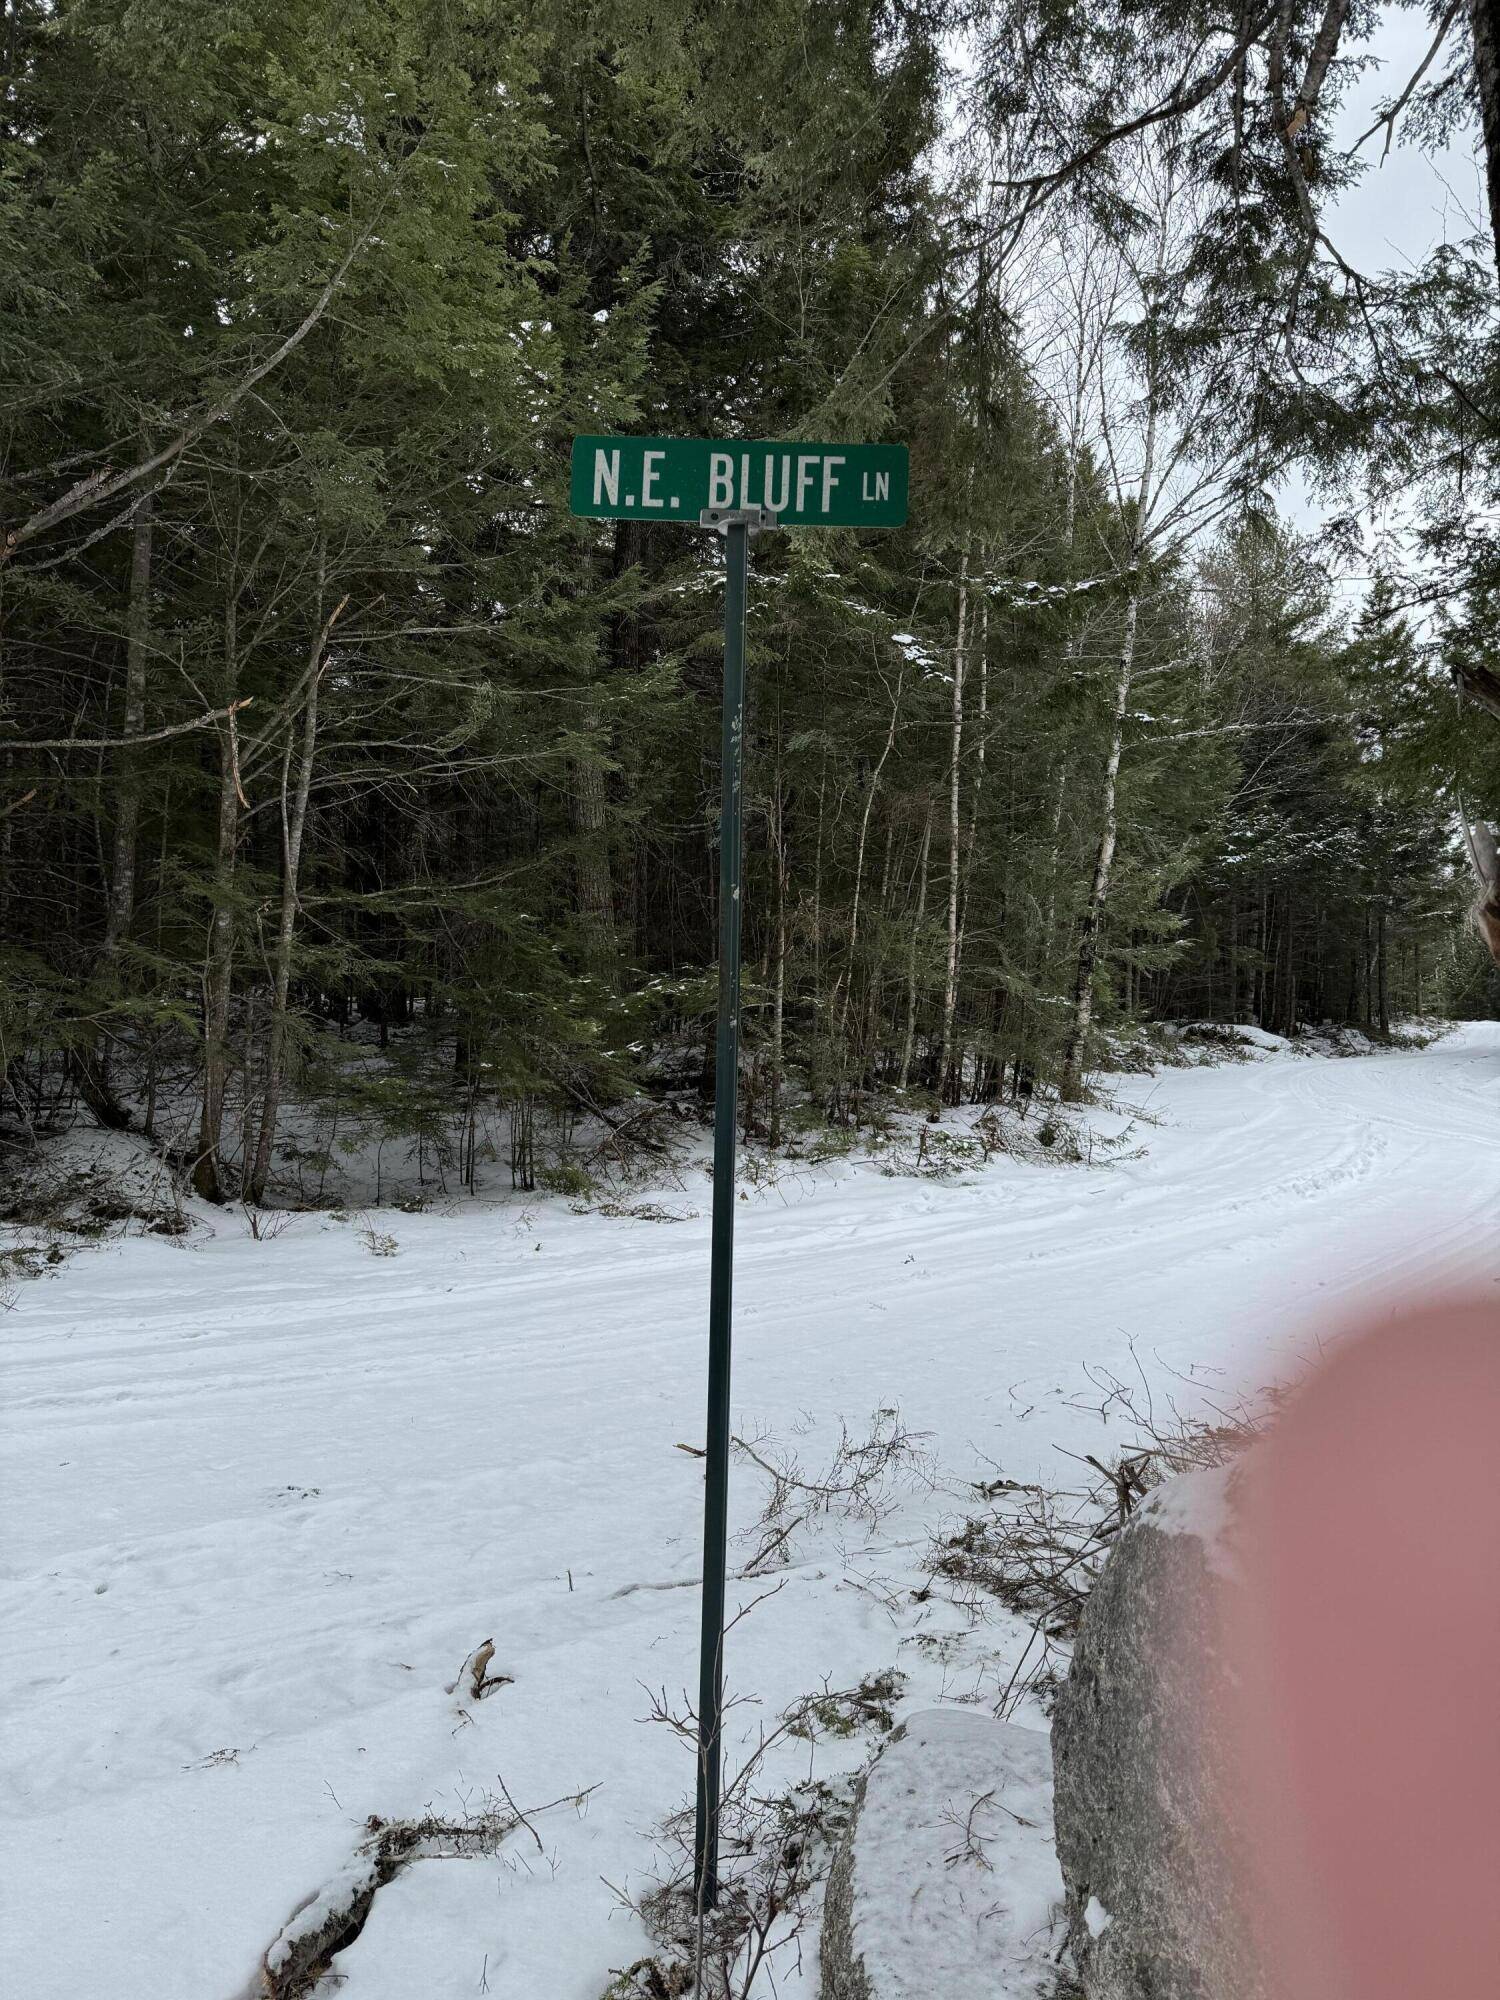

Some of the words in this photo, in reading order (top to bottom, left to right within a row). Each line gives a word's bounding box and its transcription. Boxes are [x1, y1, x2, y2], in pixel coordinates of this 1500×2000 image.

[593, 449, 680, 508] N.E.
[708, 453, 846, 512] BLUFF
[862, 472, 889, 501] LN
